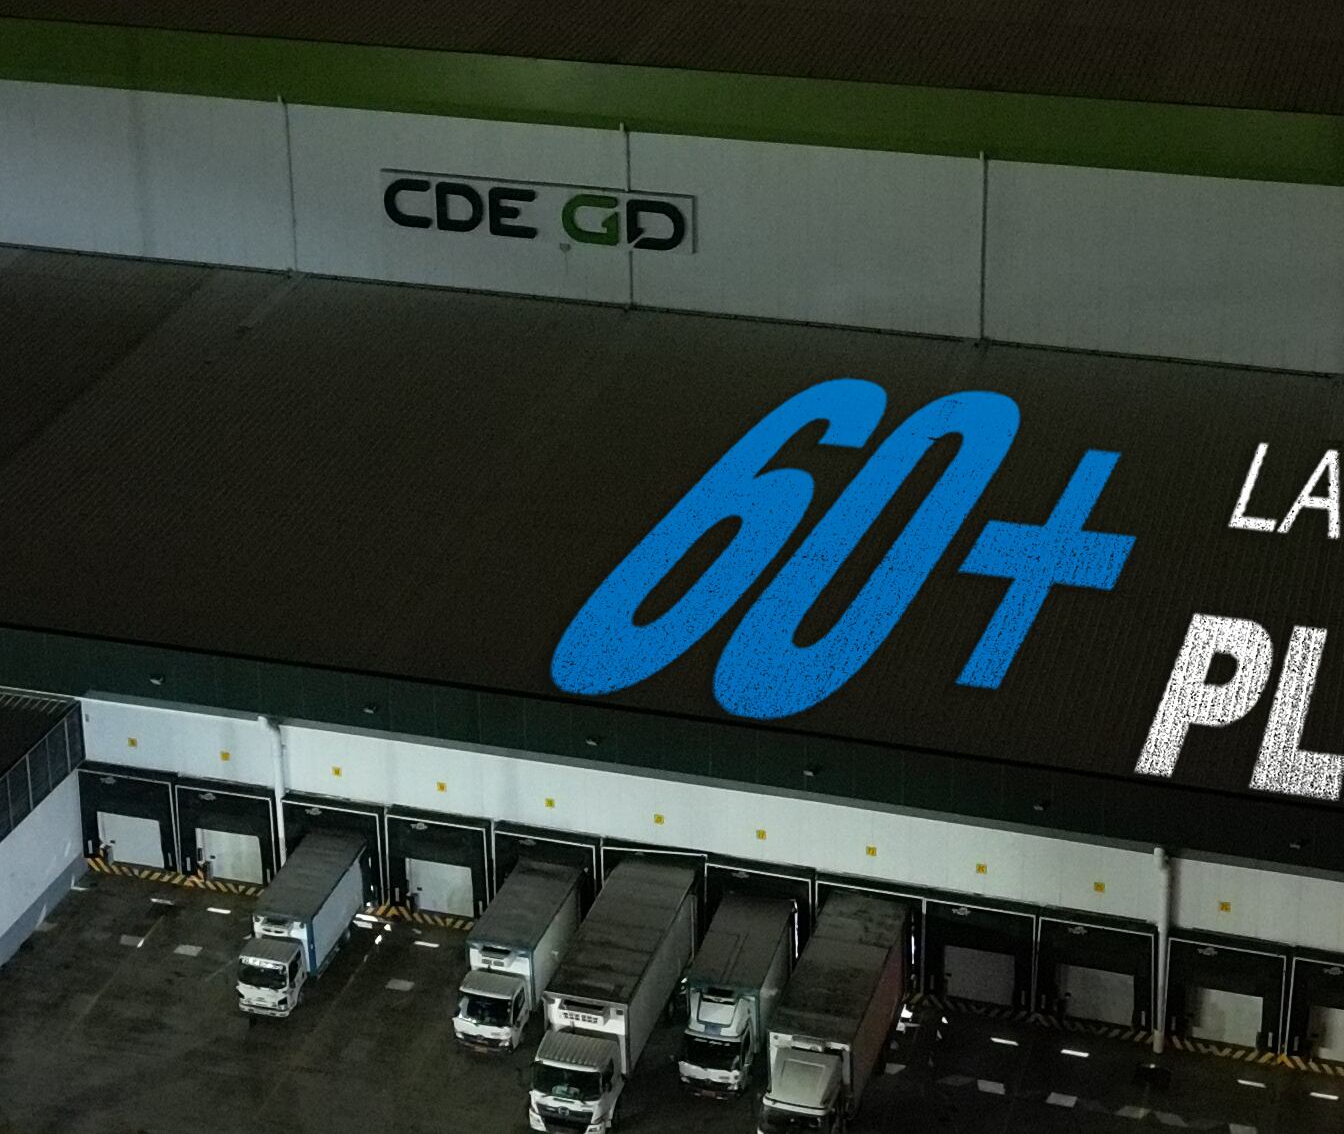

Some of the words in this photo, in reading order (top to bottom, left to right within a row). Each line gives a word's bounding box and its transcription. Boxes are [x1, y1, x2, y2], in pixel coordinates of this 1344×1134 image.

[383, 177, 538, 239] CDE
[1228, 443, 1342, 539] LA
[550, 378, 1137, 720] 60+
